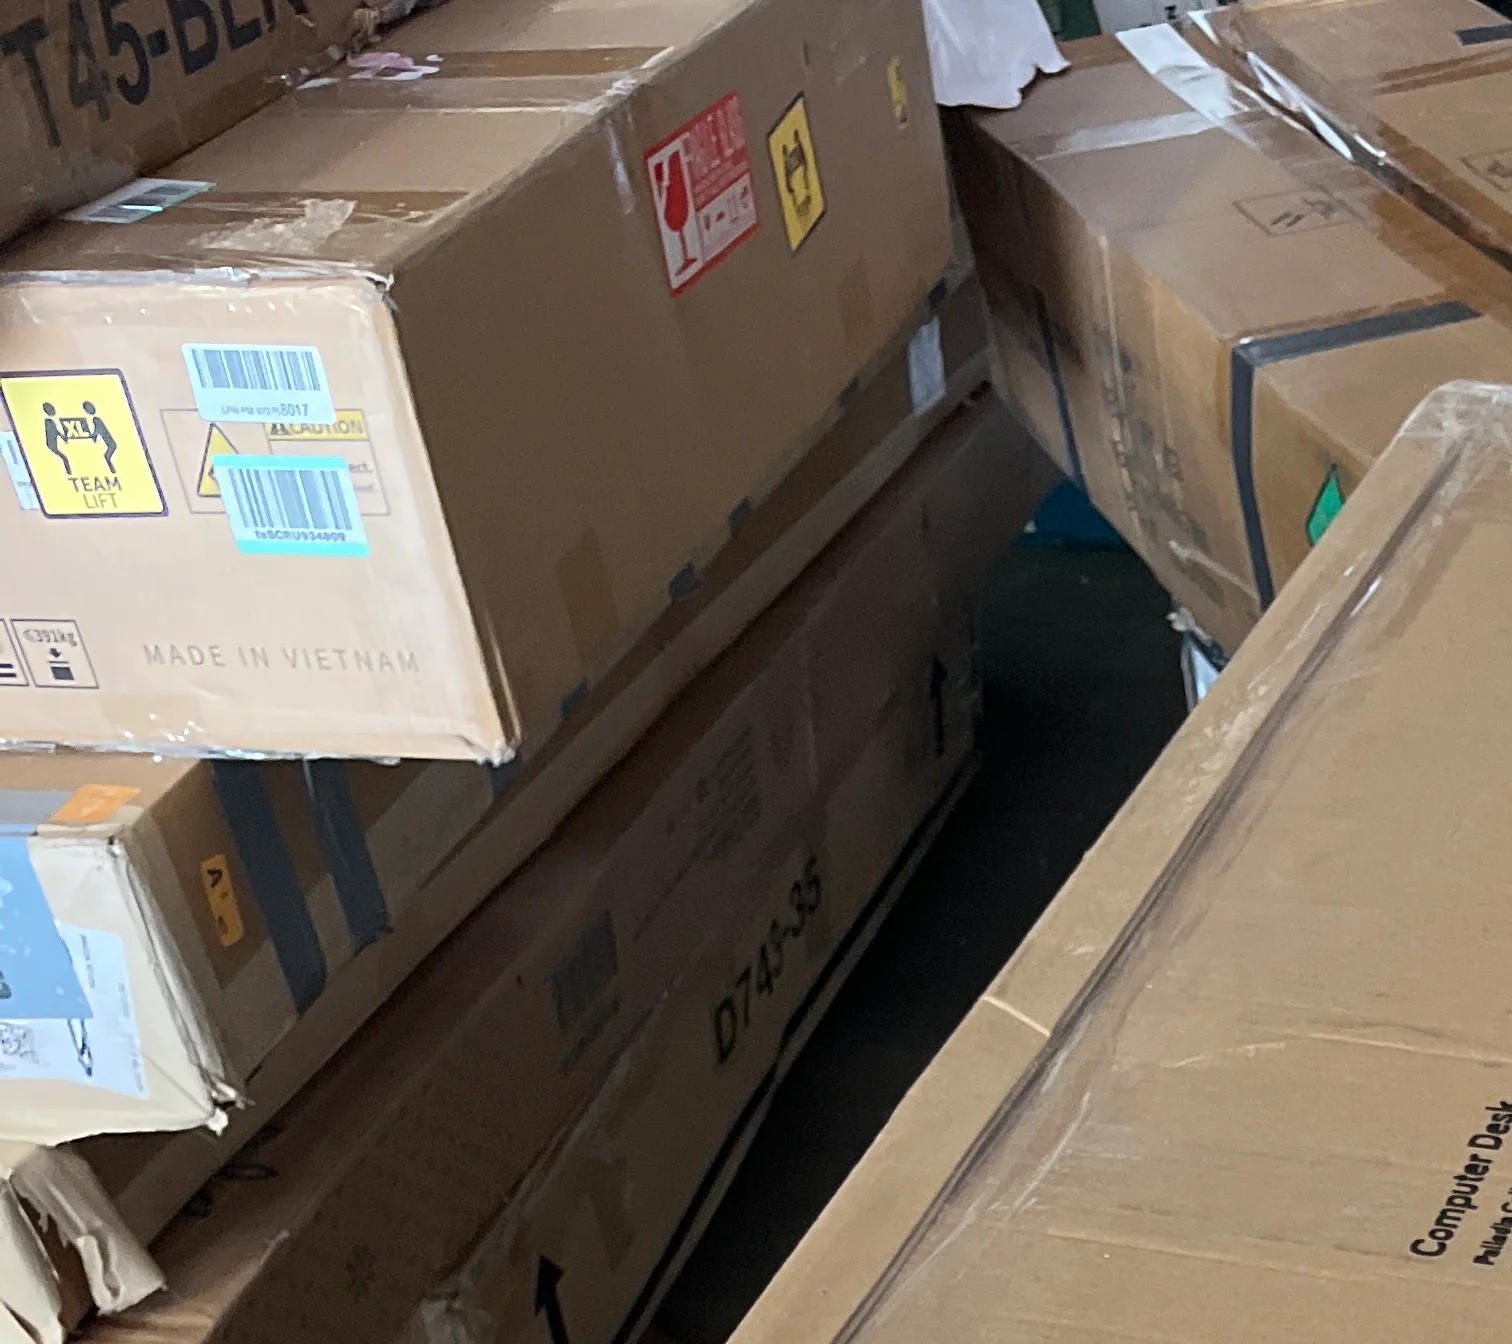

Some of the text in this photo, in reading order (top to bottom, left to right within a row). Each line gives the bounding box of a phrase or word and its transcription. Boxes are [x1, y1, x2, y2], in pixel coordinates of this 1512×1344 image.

[63, 420, 90, 438] XL
[68, 476, 122, 492] TEAM
[83, 493, 118, 508] LIFT
[142, 644, 421, 674] MADE IN VIETNAM
[1410, 1154, 1493, 1256] Computer
